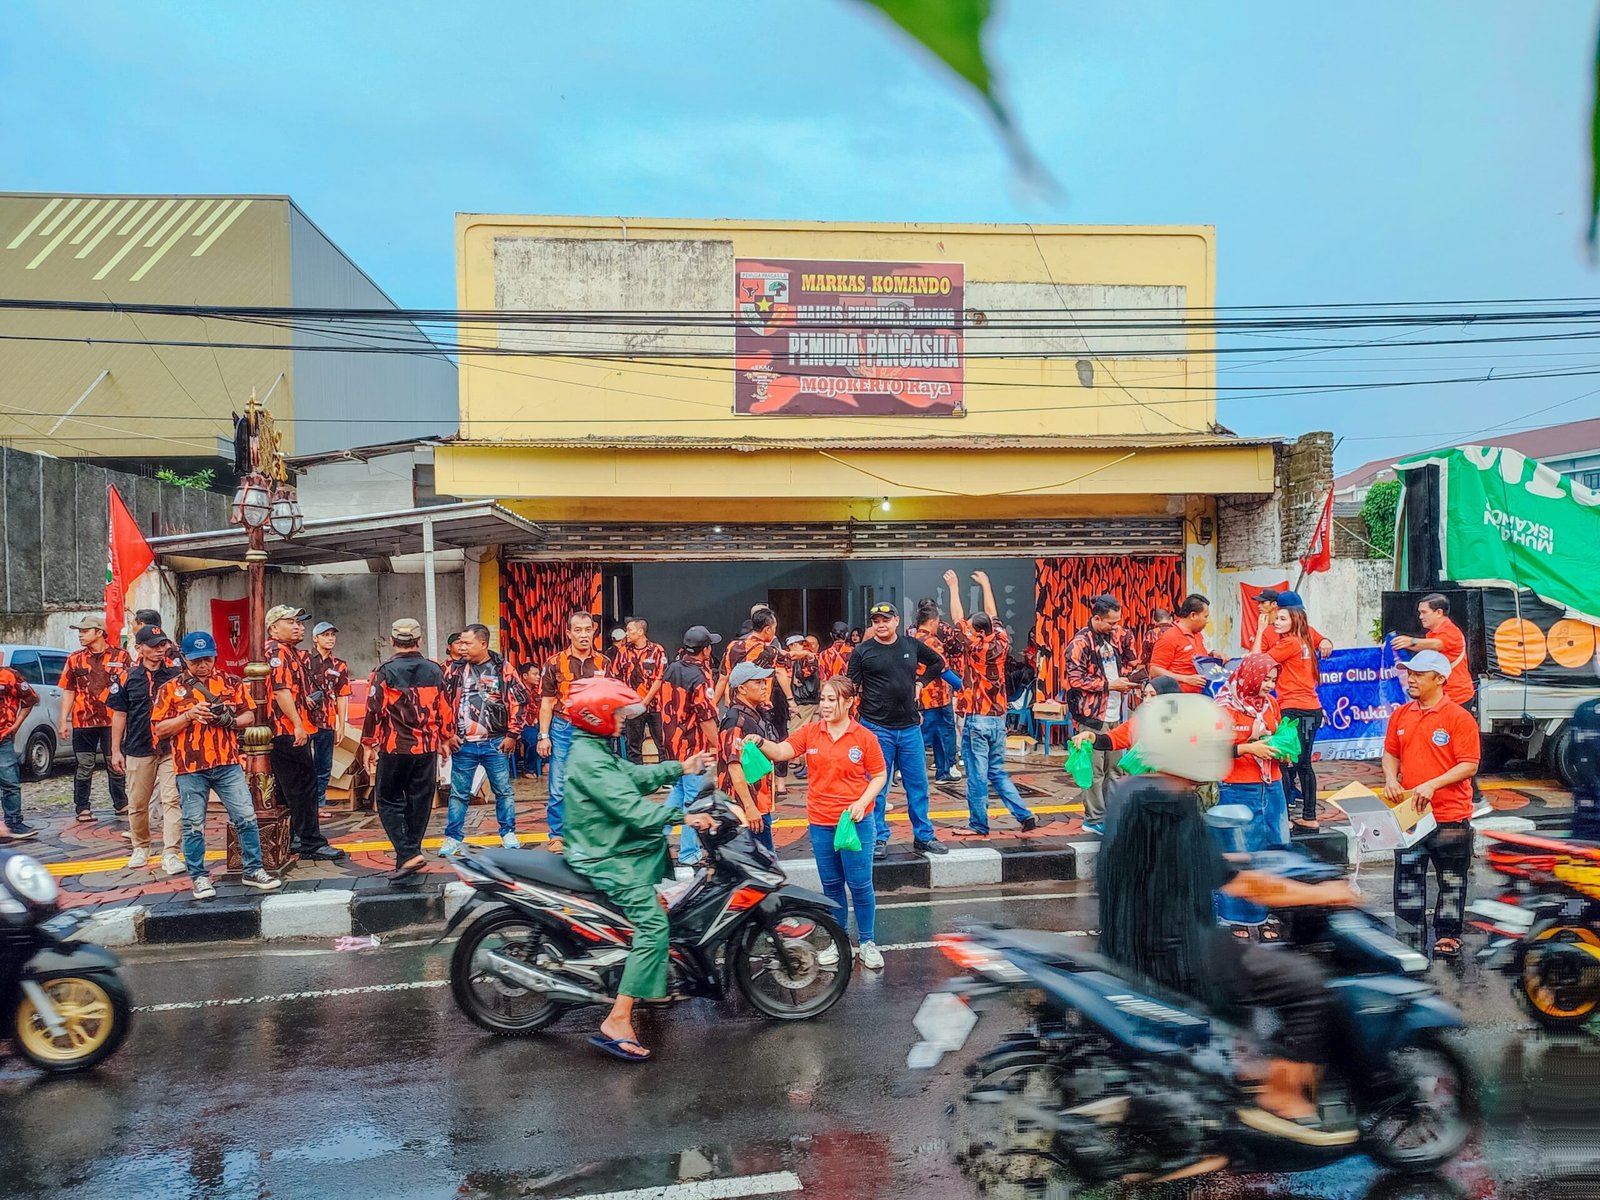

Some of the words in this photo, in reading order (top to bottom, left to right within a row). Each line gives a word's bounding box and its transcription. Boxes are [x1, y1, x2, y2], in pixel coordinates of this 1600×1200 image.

[801, 274, 866, 293] MARKAS
[872, 276, 951, 295] KOMANDO
[788, 332, 859, 367] PEMUDA
[866, 334, 959, 369] PANCASILA
[800, 376, 904, 397] MOJOKERTO
[907, 378, 952, 399] Raya
[1319, 671, 1343, 684] ner
[1346, 667, 1377, 682] Club
